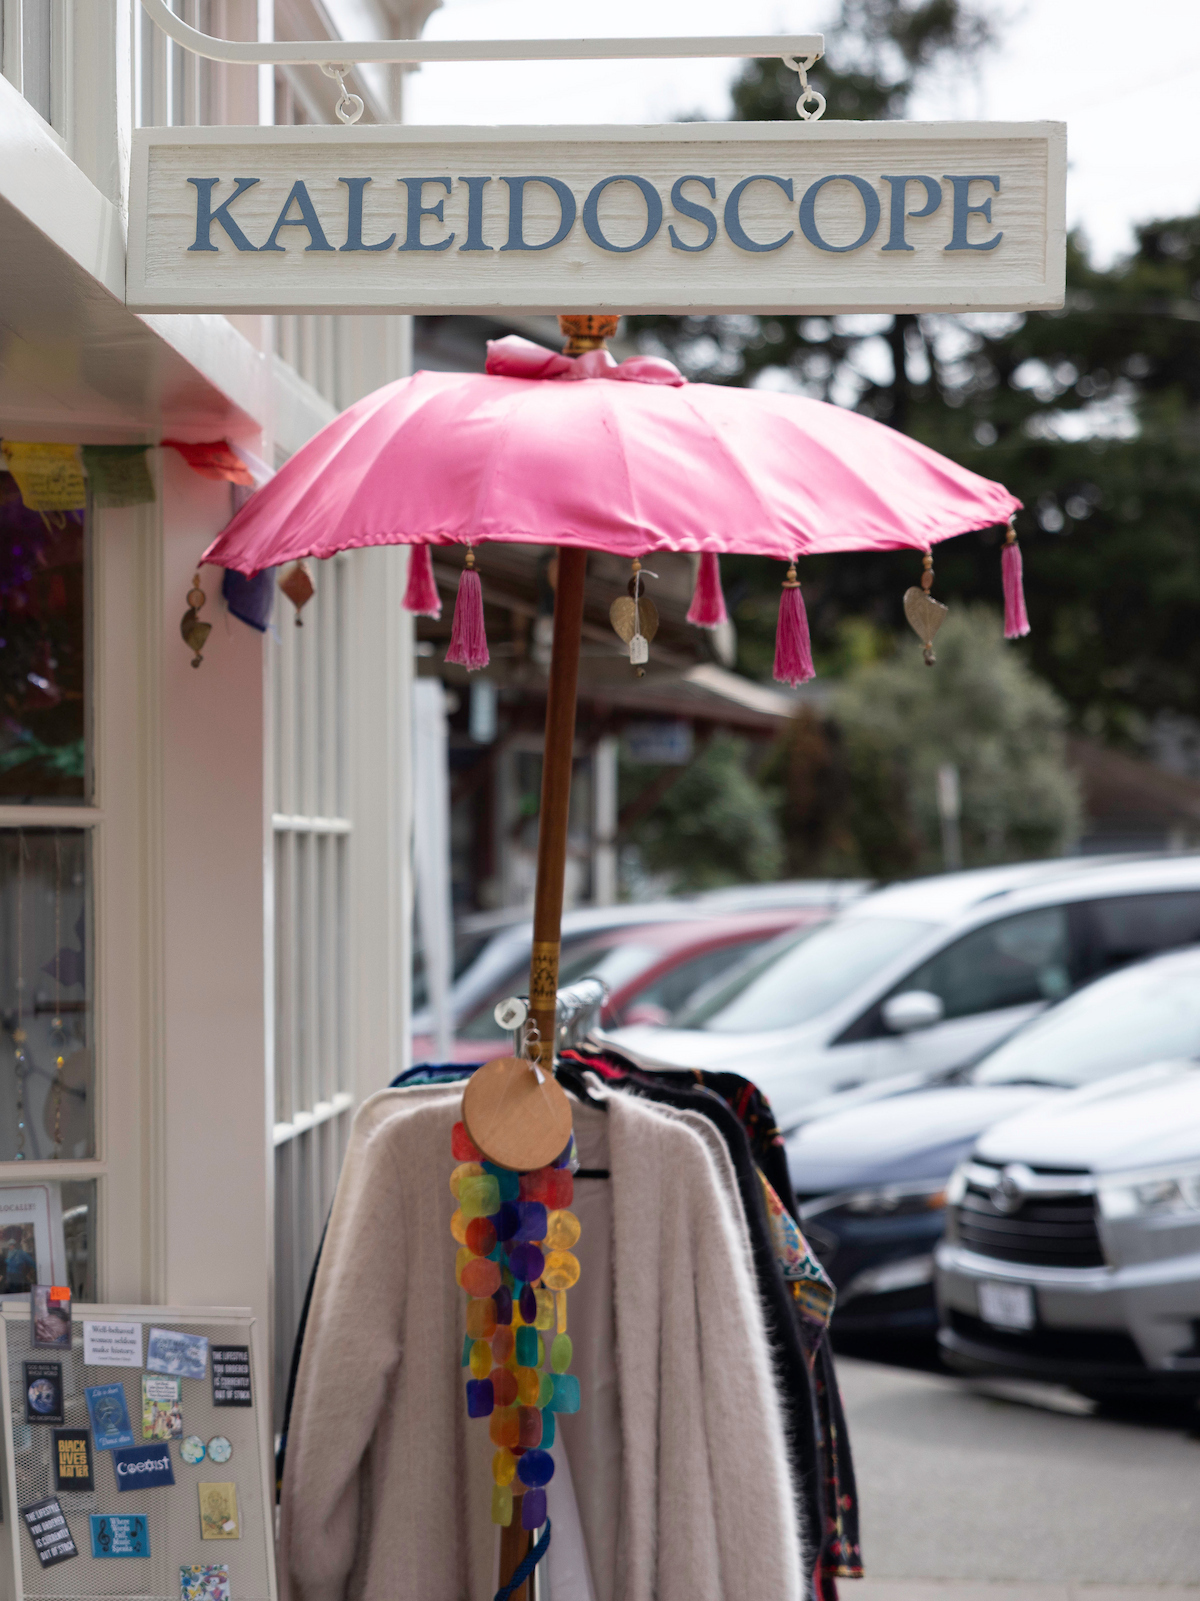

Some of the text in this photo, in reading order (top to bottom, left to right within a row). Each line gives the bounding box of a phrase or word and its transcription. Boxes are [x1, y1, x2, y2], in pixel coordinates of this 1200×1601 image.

[187, 174, 1004, 253] KALEIDOSCOPE
[212, 1352, 248, 1360] THE LIFESTYLE
[58, 1440, 86, 1452] BLACK
[59, 1452, 87, 1464] LIVES
[60, 1464, 89, 1477] MATTER
[36, 1502, 60, 1518] LIFESTYLE
[110, 1517, 130, 1525] Where
[112, 1545, 133, 1553] Speaks
